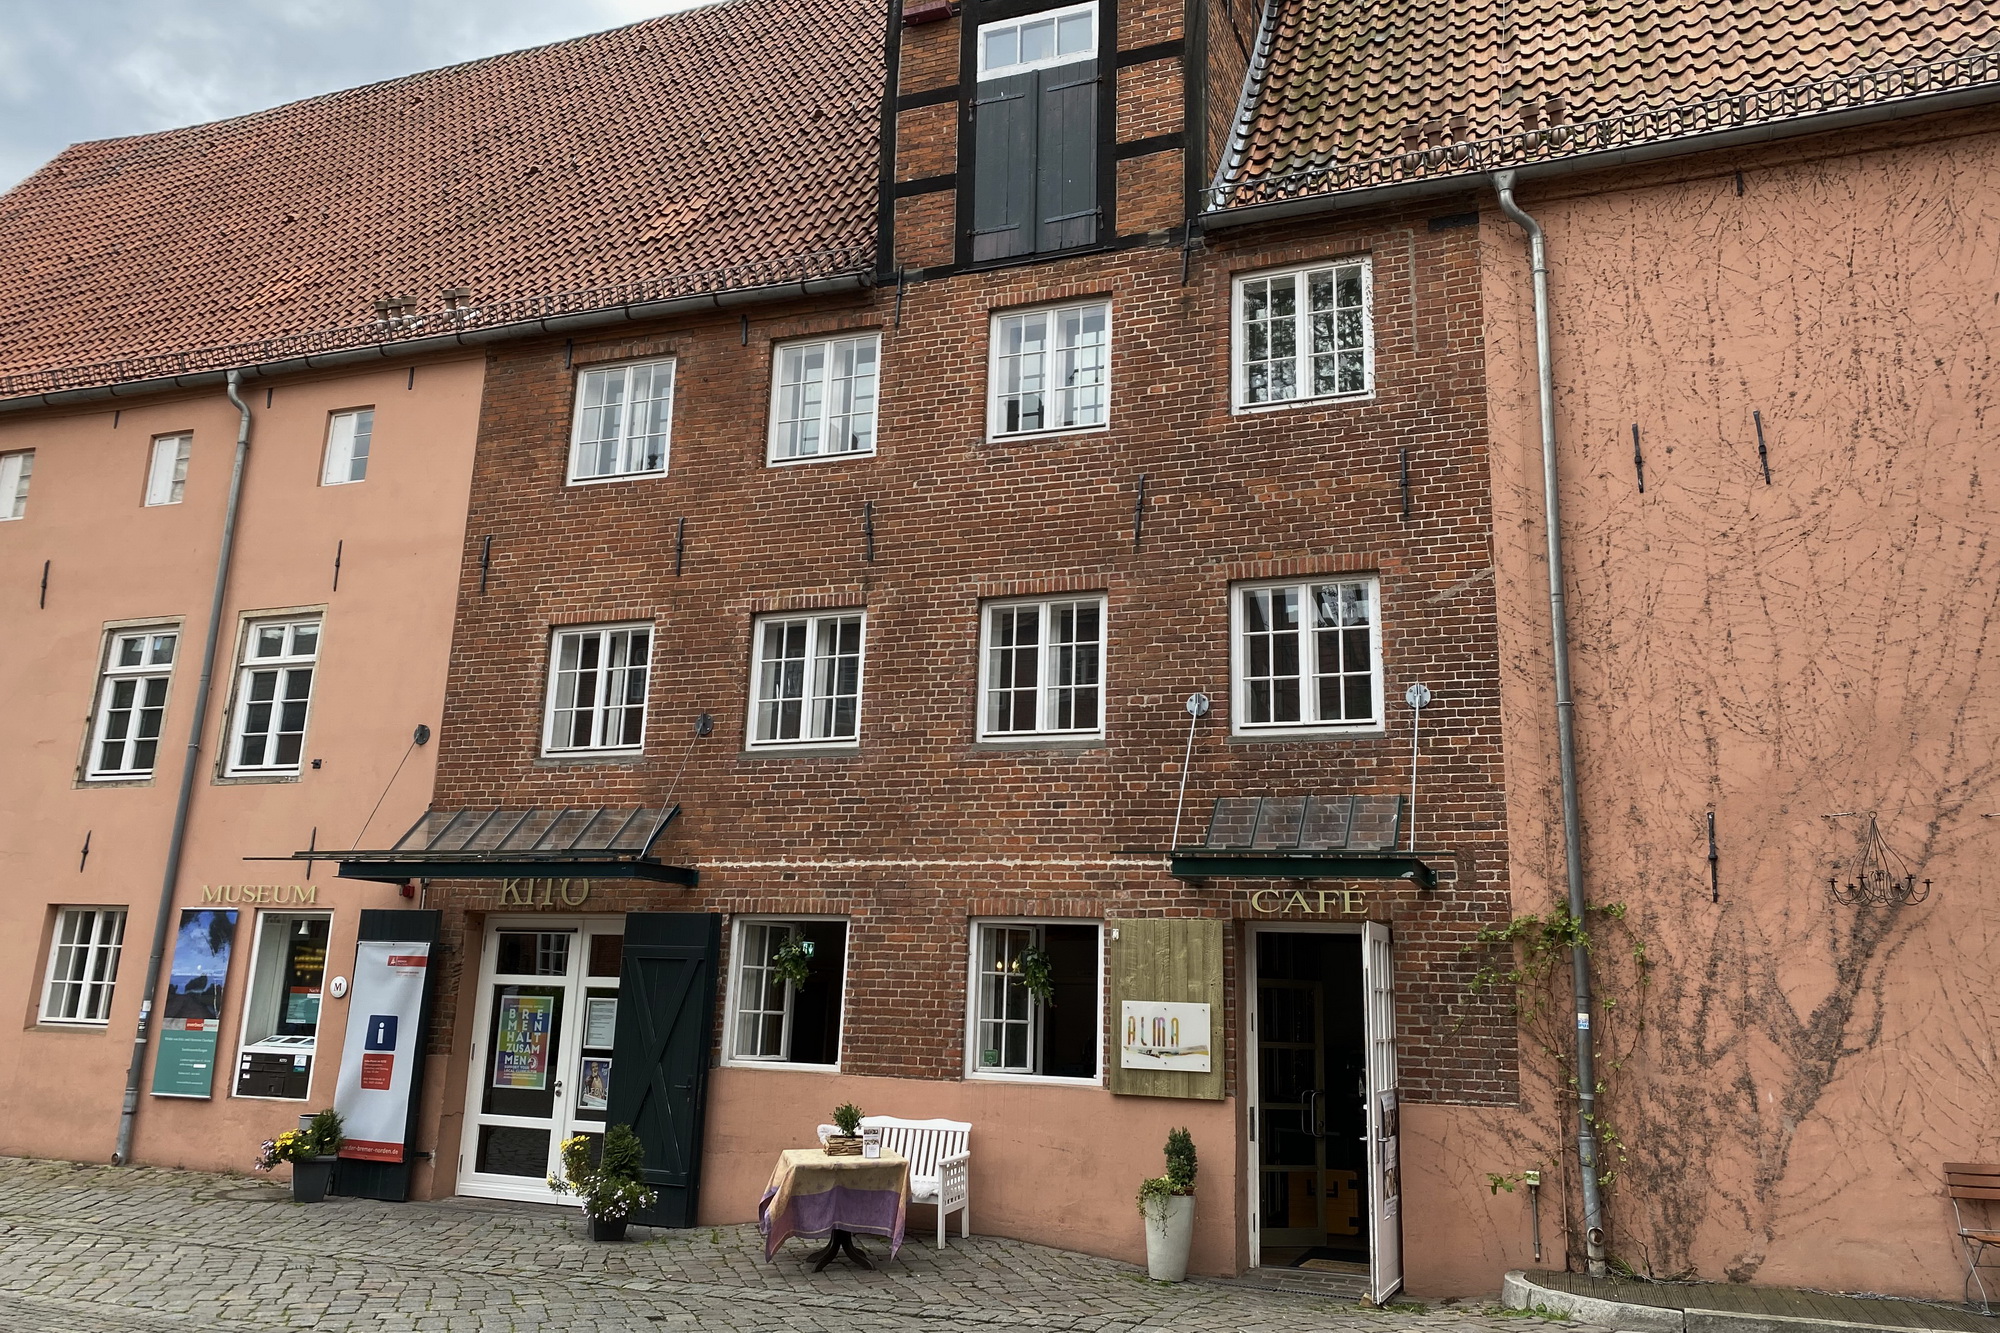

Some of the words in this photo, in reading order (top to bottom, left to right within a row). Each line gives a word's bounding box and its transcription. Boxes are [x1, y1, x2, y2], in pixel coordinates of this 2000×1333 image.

[201, 885, 317, 904] MUSEUM
[498, 878, 590, 906] KITO
[1251, 885, 1369, 914] CAFÉ
[333, 982, 342, 992] M
[506, 1030, 541, 1043] HÄLT
[1127, 1016, 1180, 1047] ALMA
[505, 1043, 540, 1055] ZUSAM
[504, 1054, 527, 1066] MEN
